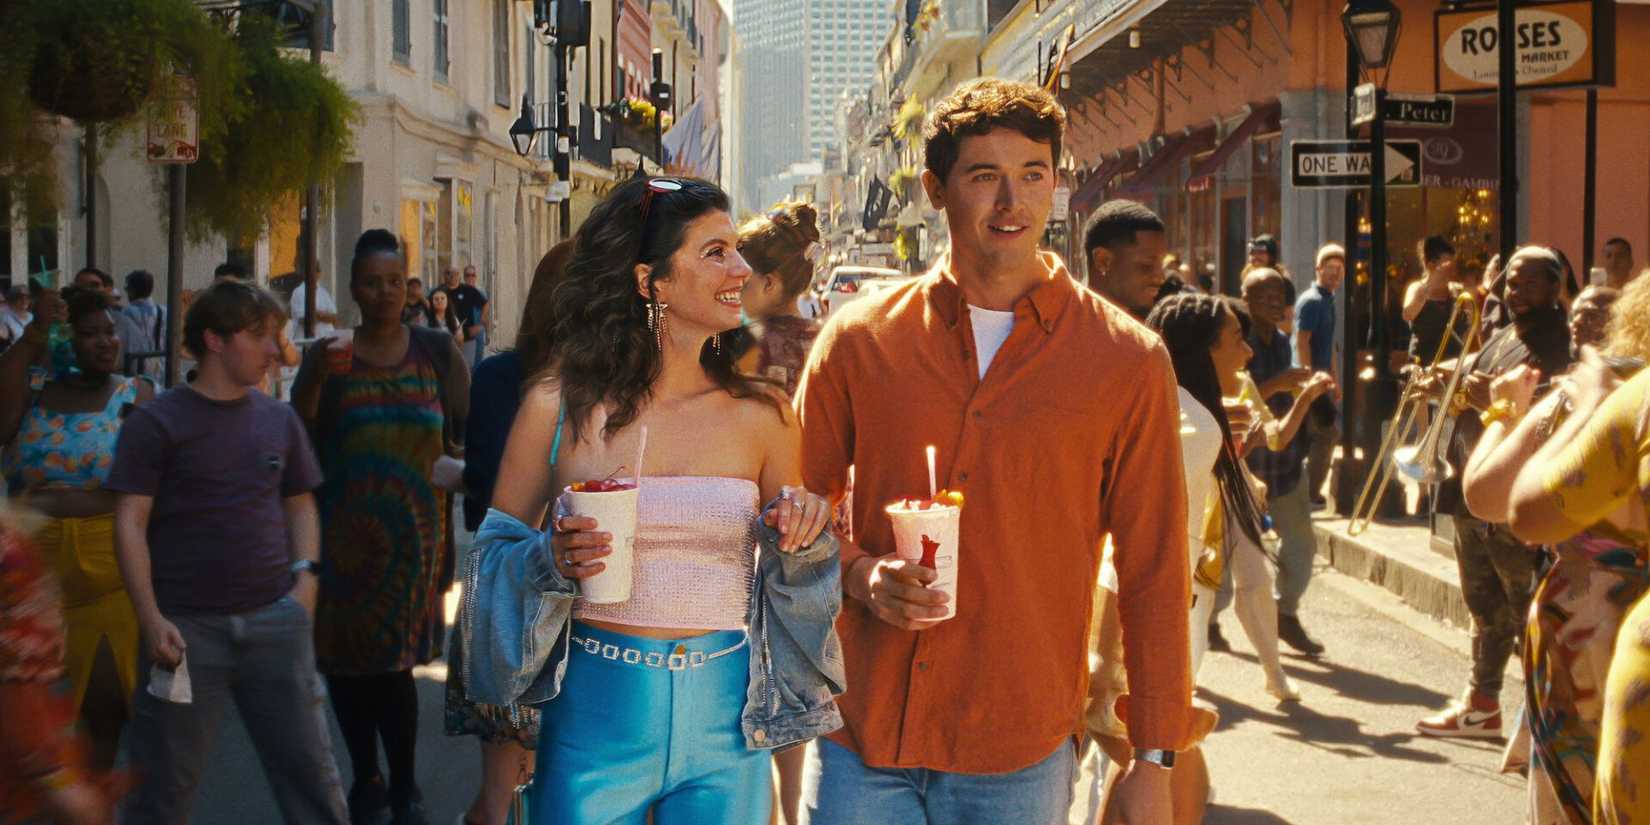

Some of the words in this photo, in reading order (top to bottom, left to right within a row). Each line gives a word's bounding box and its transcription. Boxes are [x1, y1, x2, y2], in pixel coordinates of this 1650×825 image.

[1461, 21, 1561, 55] ROSES
[1521, 50, 1569, 63] MARKET
[1400, 103, 1447, 121] Peter
[1302, 156, 1338, 173] ONE
[1345, 156, 1371, 172] WA
